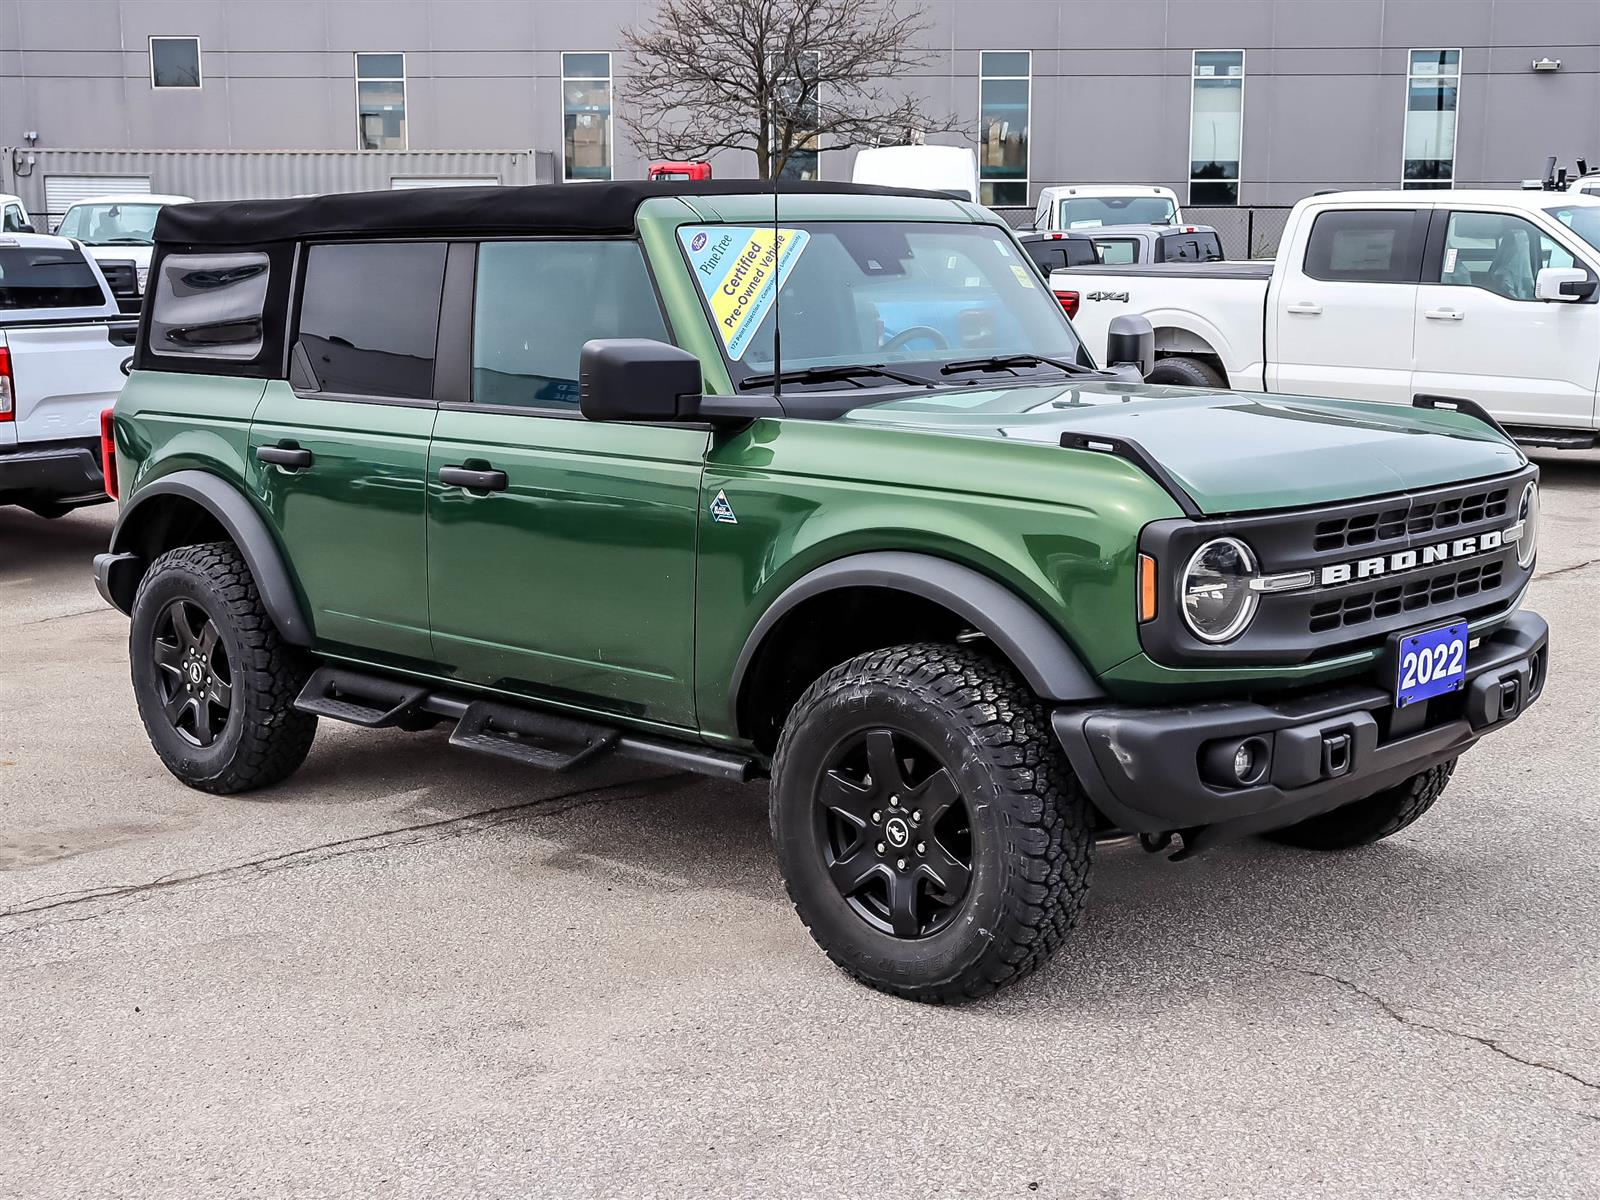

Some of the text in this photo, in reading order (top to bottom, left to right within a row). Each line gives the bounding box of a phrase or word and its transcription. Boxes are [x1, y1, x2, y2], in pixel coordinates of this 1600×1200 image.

[699, 234, 732, 276] PineTree
[723, 241, 762, 296] Certified
[724, 268, 765, 328] Pre-Owned
[1321, 531, 1502, 585] BRONCO
[1401, 639, 1464, 691] 2022
